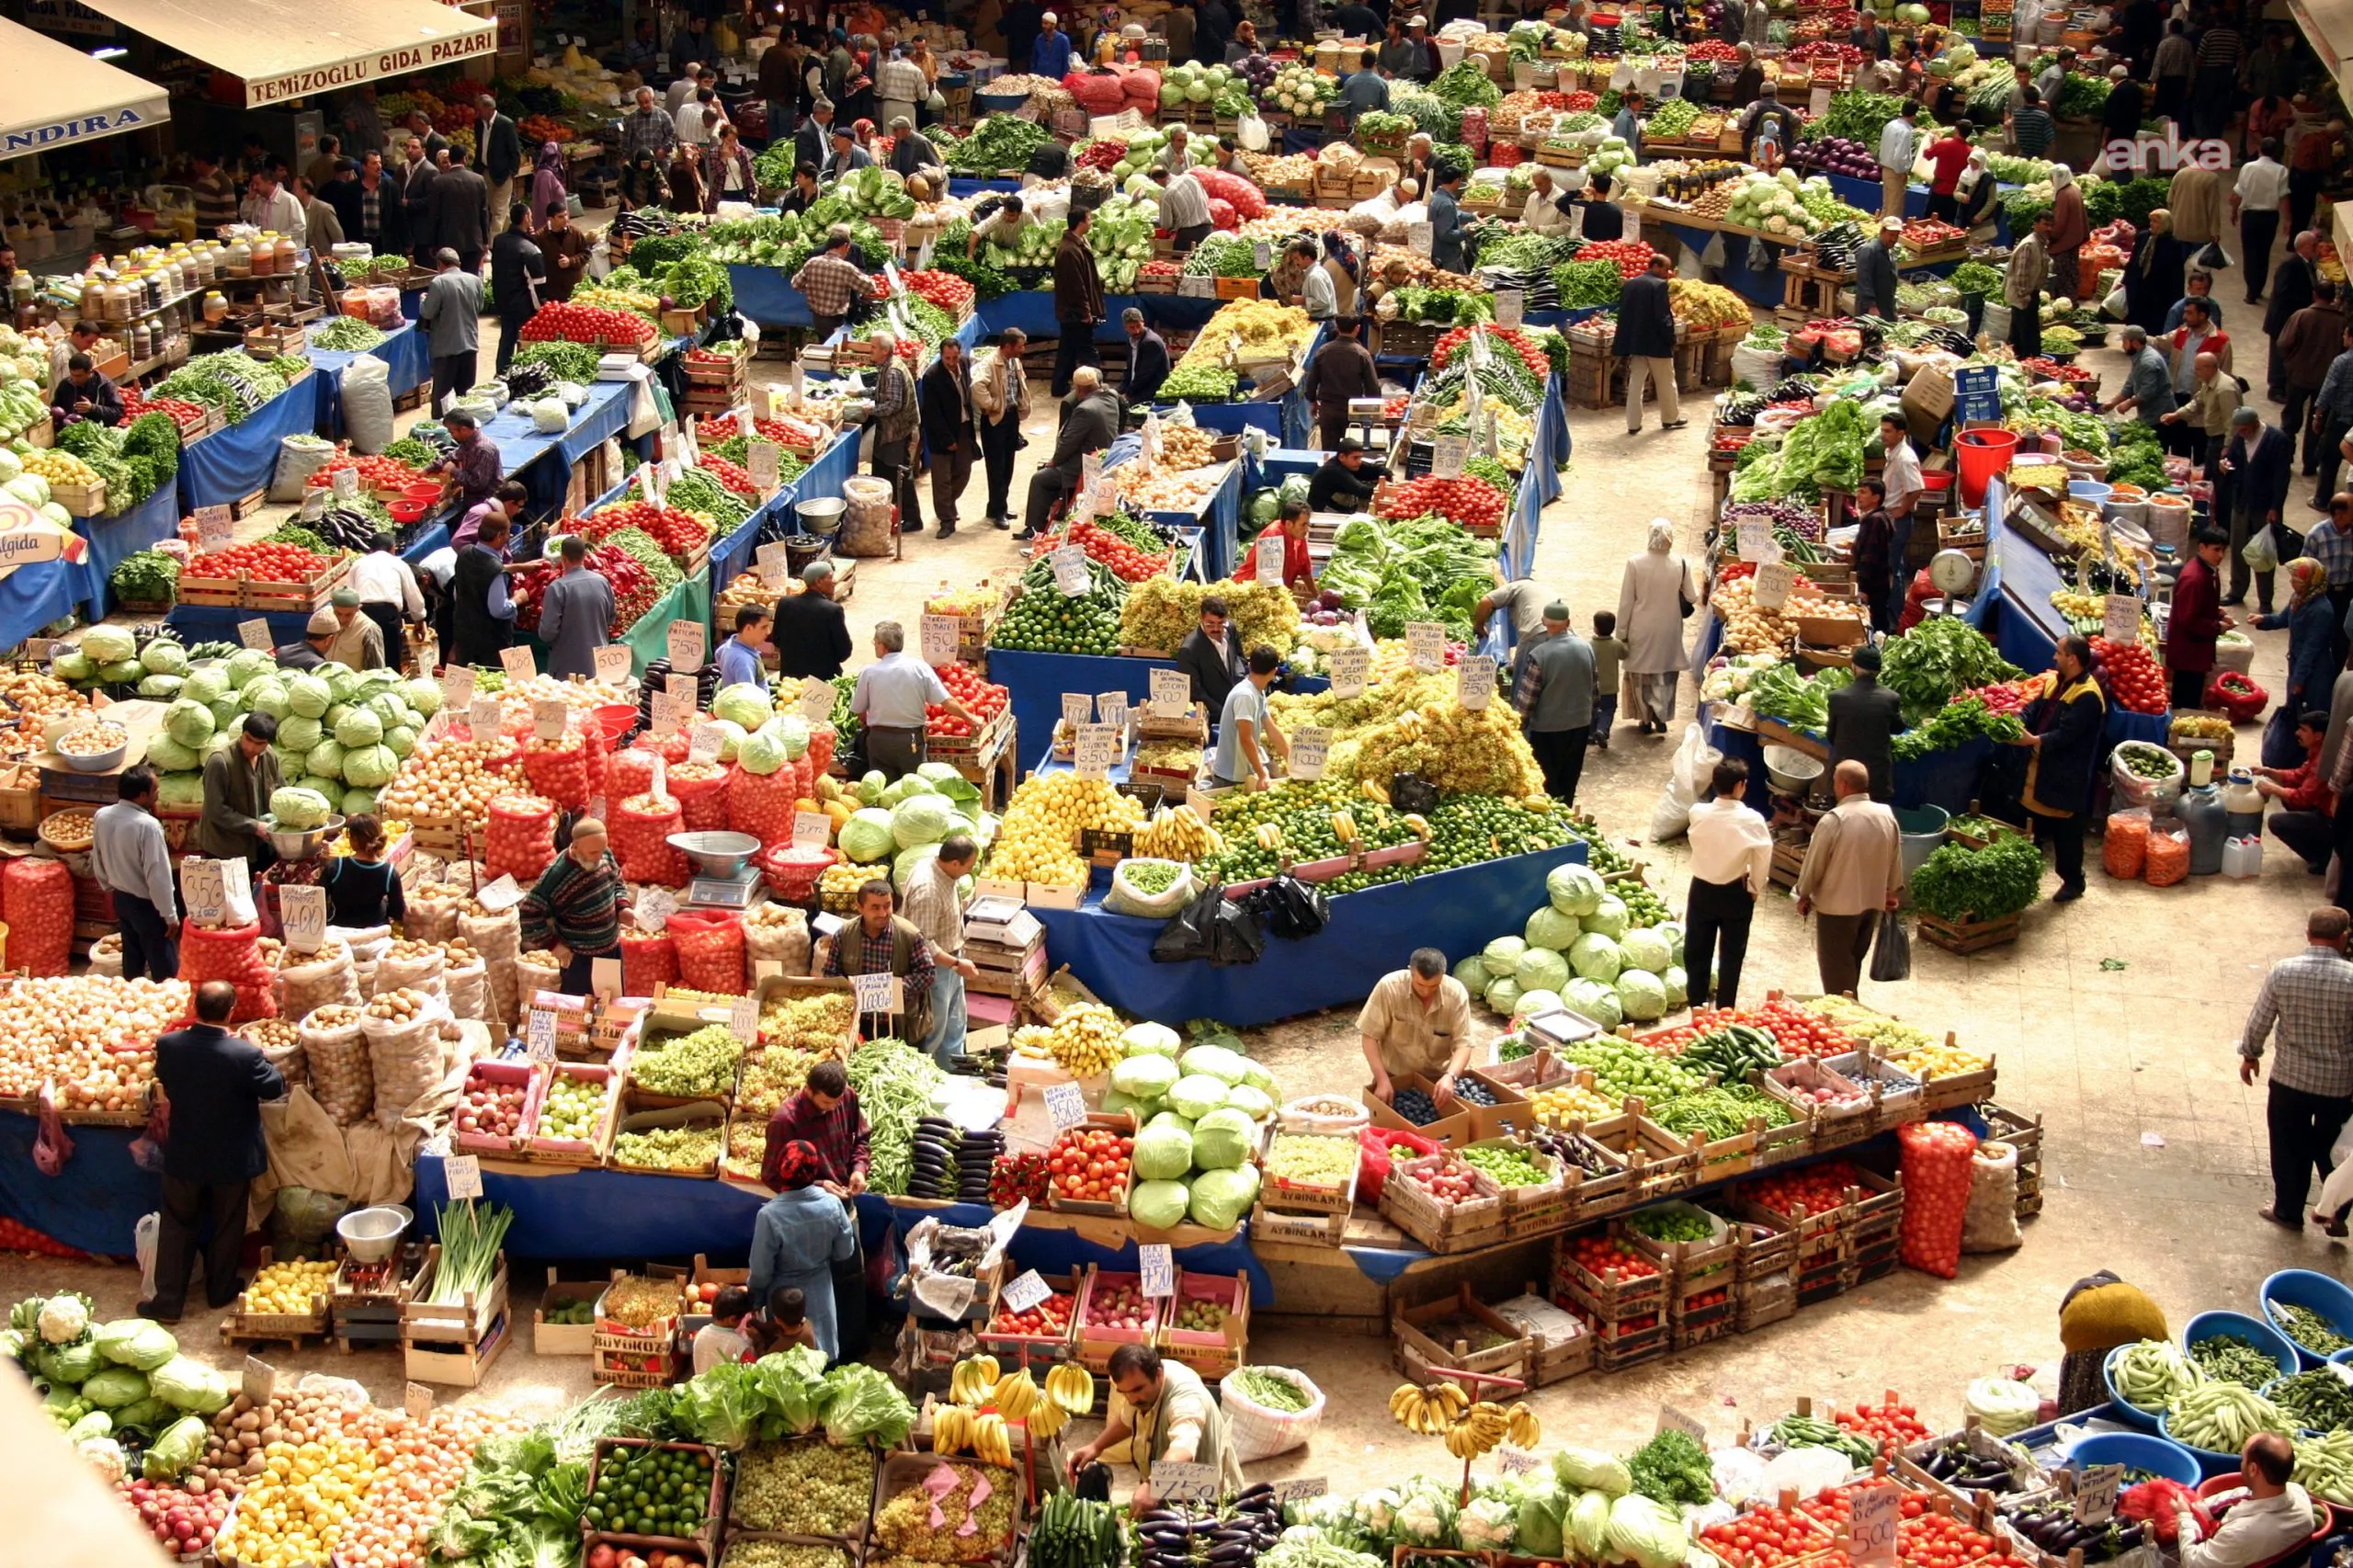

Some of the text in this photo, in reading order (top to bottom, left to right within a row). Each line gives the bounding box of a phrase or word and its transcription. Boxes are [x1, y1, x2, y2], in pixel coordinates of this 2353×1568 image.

[379, 48, 423, 73] GIDA
[431, 32, 493, 62] PAZARI
[0, 108, 143, 153] NDIRA
[0, 534, 40, 559] lgida
[1759, 576, 1788, 593] 500
[671, 639, 700, 656] 750
[923, 631, 952, 646] 350
[597, 652, 625, 669] 500
[1335, 675, 1361, 686] 750
[1462, 682, 1490, 697] 750
[802, 689, 834, 709] 400
[1151, 691, 1182, 704] 500
[1078, 750, 1109, 764] 650
[796, 823, 806, 835] 5
[184, 875, 224, 908] 350
[283, 905, 324, 936] 400
[530, 1031, 555, 1057] 750
[1050, 1097, 1075, 1123] 350
[1142, 1265, 1171, 1290] 750
[408, 1385, 431, 1400] 500
[1154, 1481, 1215, 1500] 750
[2080, 1489, 2114, 1517] 750
[1851, 1520, 1893, 1556] 500
